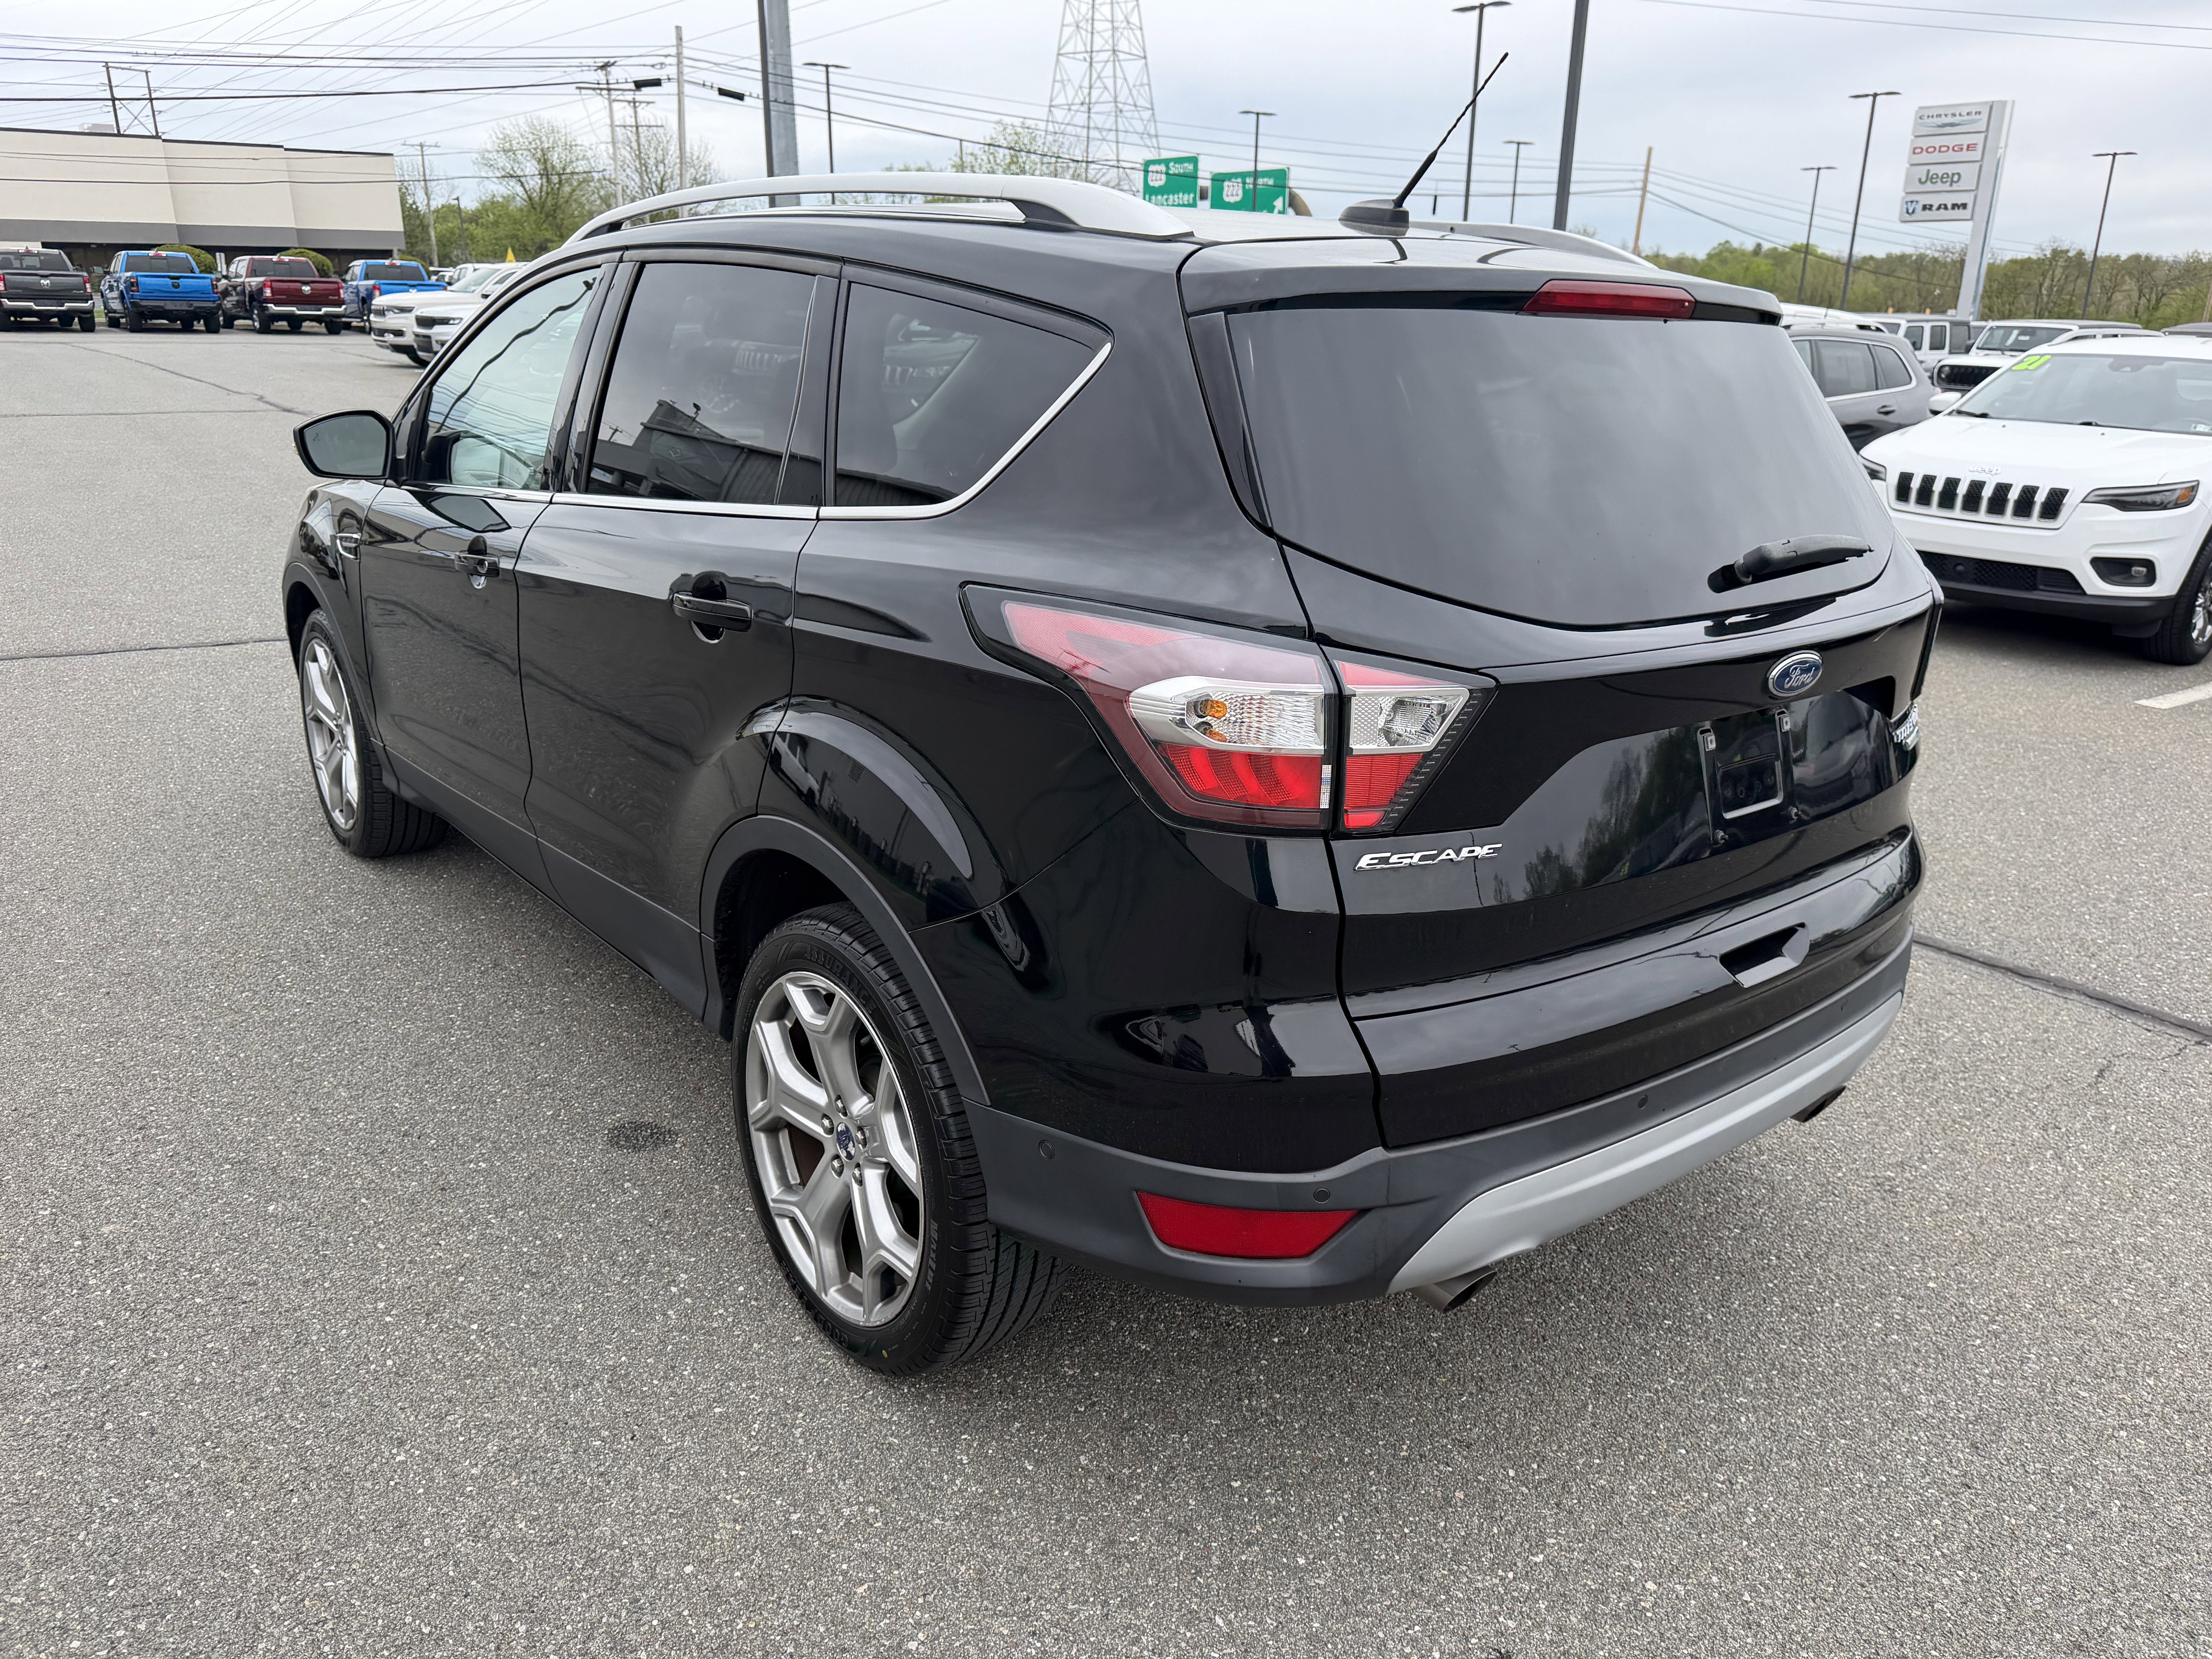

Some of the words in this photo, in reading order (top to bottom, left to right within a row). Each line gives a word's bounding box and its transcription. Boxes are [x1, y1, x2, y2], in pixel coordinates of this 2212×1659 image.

[1919, 110, 1982, 120] CHRYSLER
[1912, 143, 1978, 155] DODGE
[1918, 169, 1961, 187] Jeep
[1921, 203, 1968, 212] RAM
[2011, 355, 2051, 370] 21
[1968, 464, 2002, 476] Jeep
[1784, 663, 1815, 689] Ford
[1355, 843, 1503, 871] ESCAPE
[804, 945, 877, 1015] ASSURANCE
